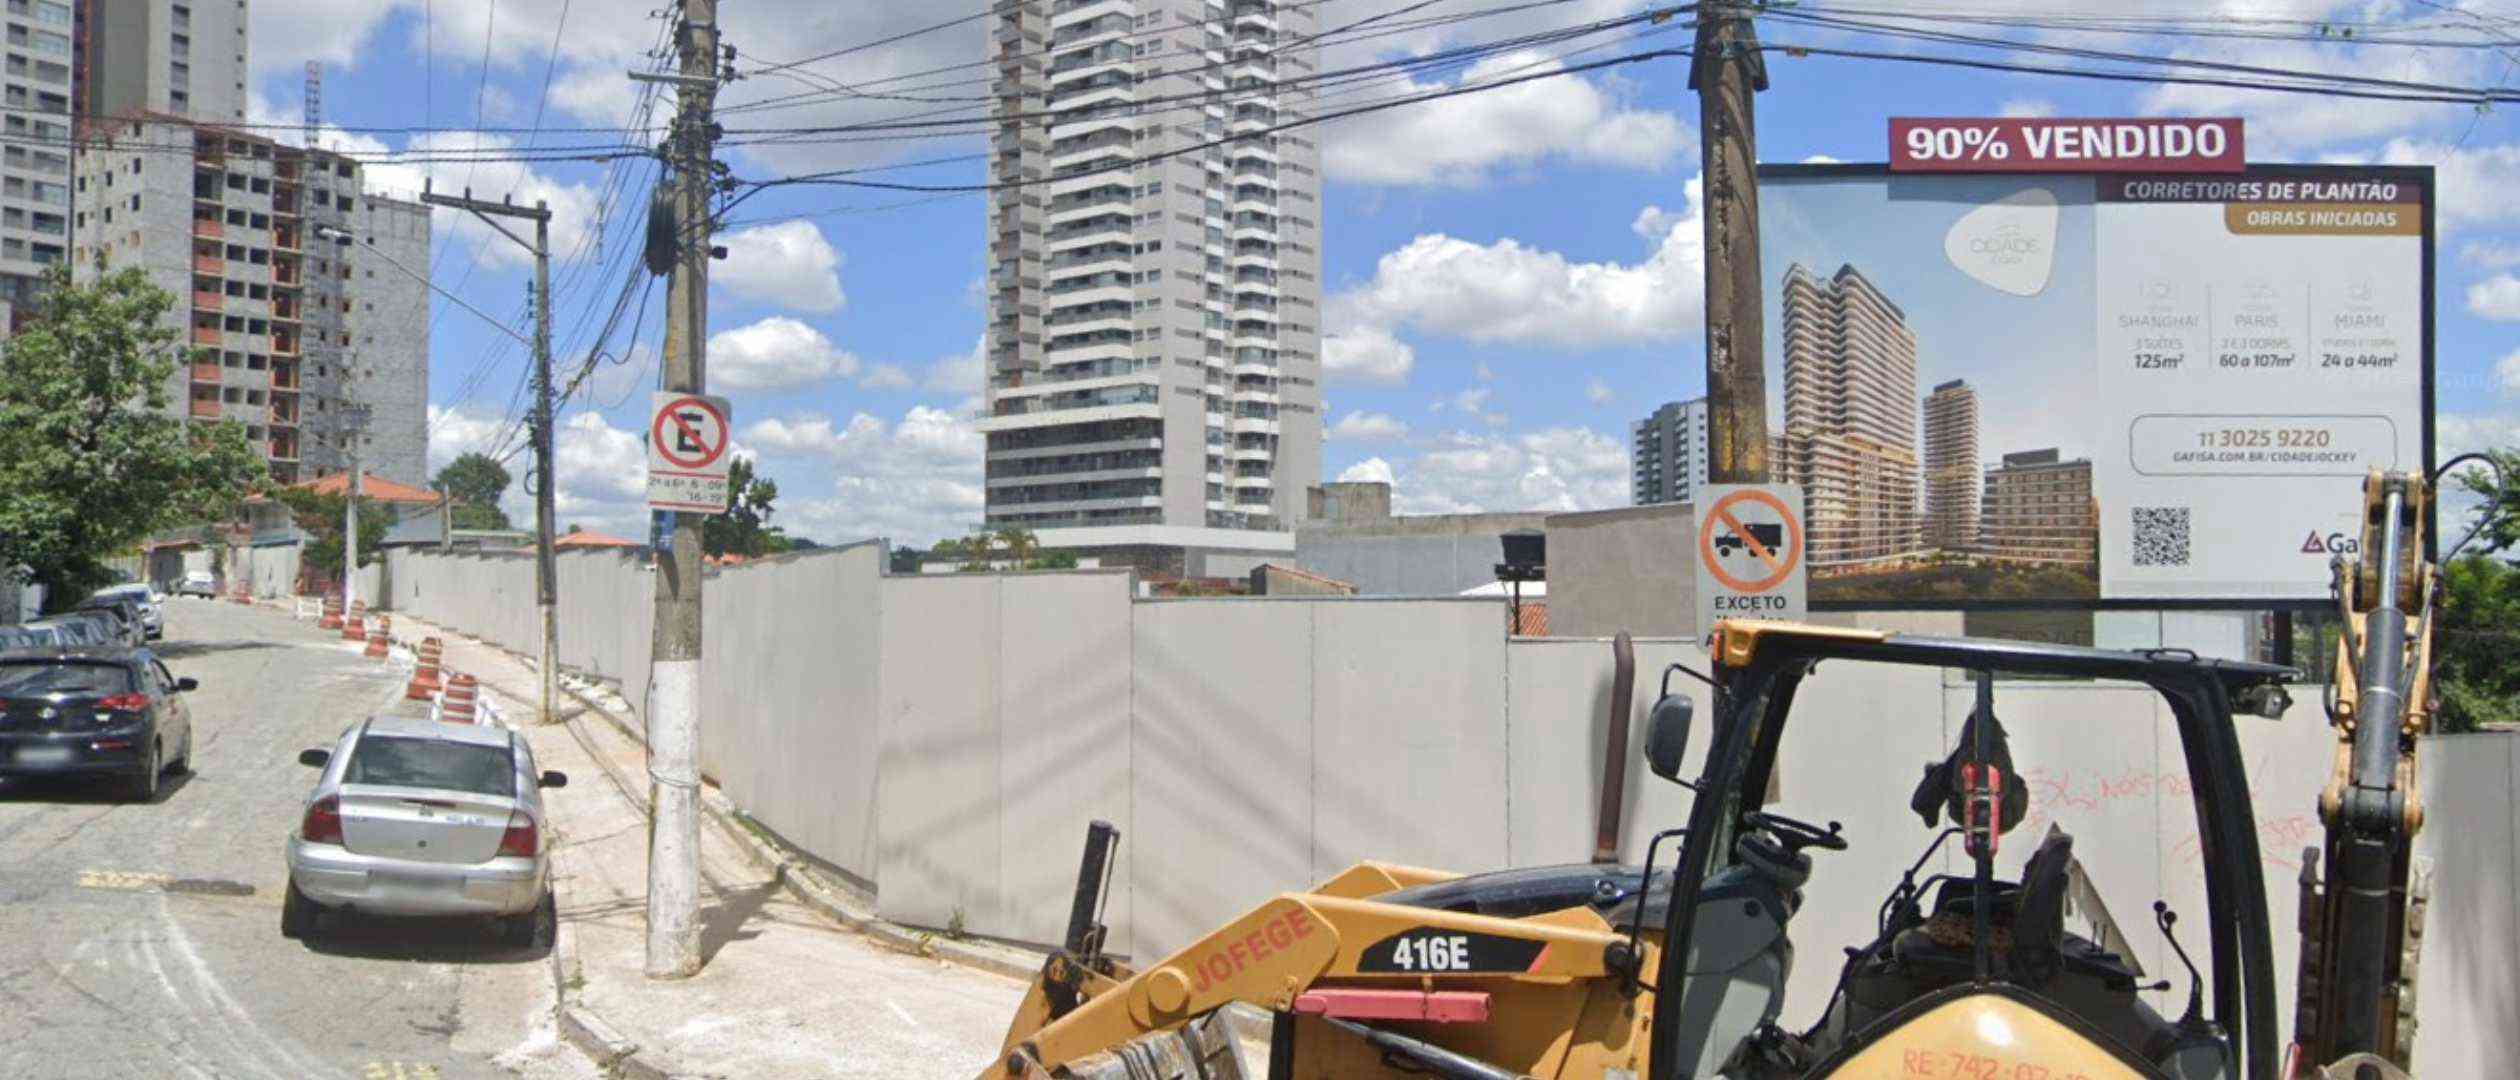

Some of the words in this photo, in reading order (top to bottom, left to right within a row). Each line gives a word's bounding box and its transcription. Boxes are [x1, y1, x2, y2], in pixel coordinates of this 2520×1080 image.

[1907, 126, 2009, 160] 90%
[2022, 123, 2226, 159] VENDIDO
[2124, 181, 2261, 200] CORRETORES
[2268, 182, 2294, 199] DE
[2301, 178, 2397, 200] PLANTÃO
[2247, 211, 2305, 226] OBRAS
[2310, 211, 2397, 227] INICIADAS
[2119, 315, 2200, 329] SHANGHAI
[2234, 315, 2279, 328] PARIS
[2335, 315, 2385, 329] MIAMI
[2219, 355, 2238, 367] 60
[2321, 354, 2340, 367] 24
[2198, 432, 2214, 446] 11
[2221, 430, 2271, 447] 3025
[2278, 430, 2330, 447] 9220
[1715, 596, 1787, 610] EXCETO
[1195, 906, 1314, 993] JOFEGE
[1393, 936, 1469, 969] 416E
